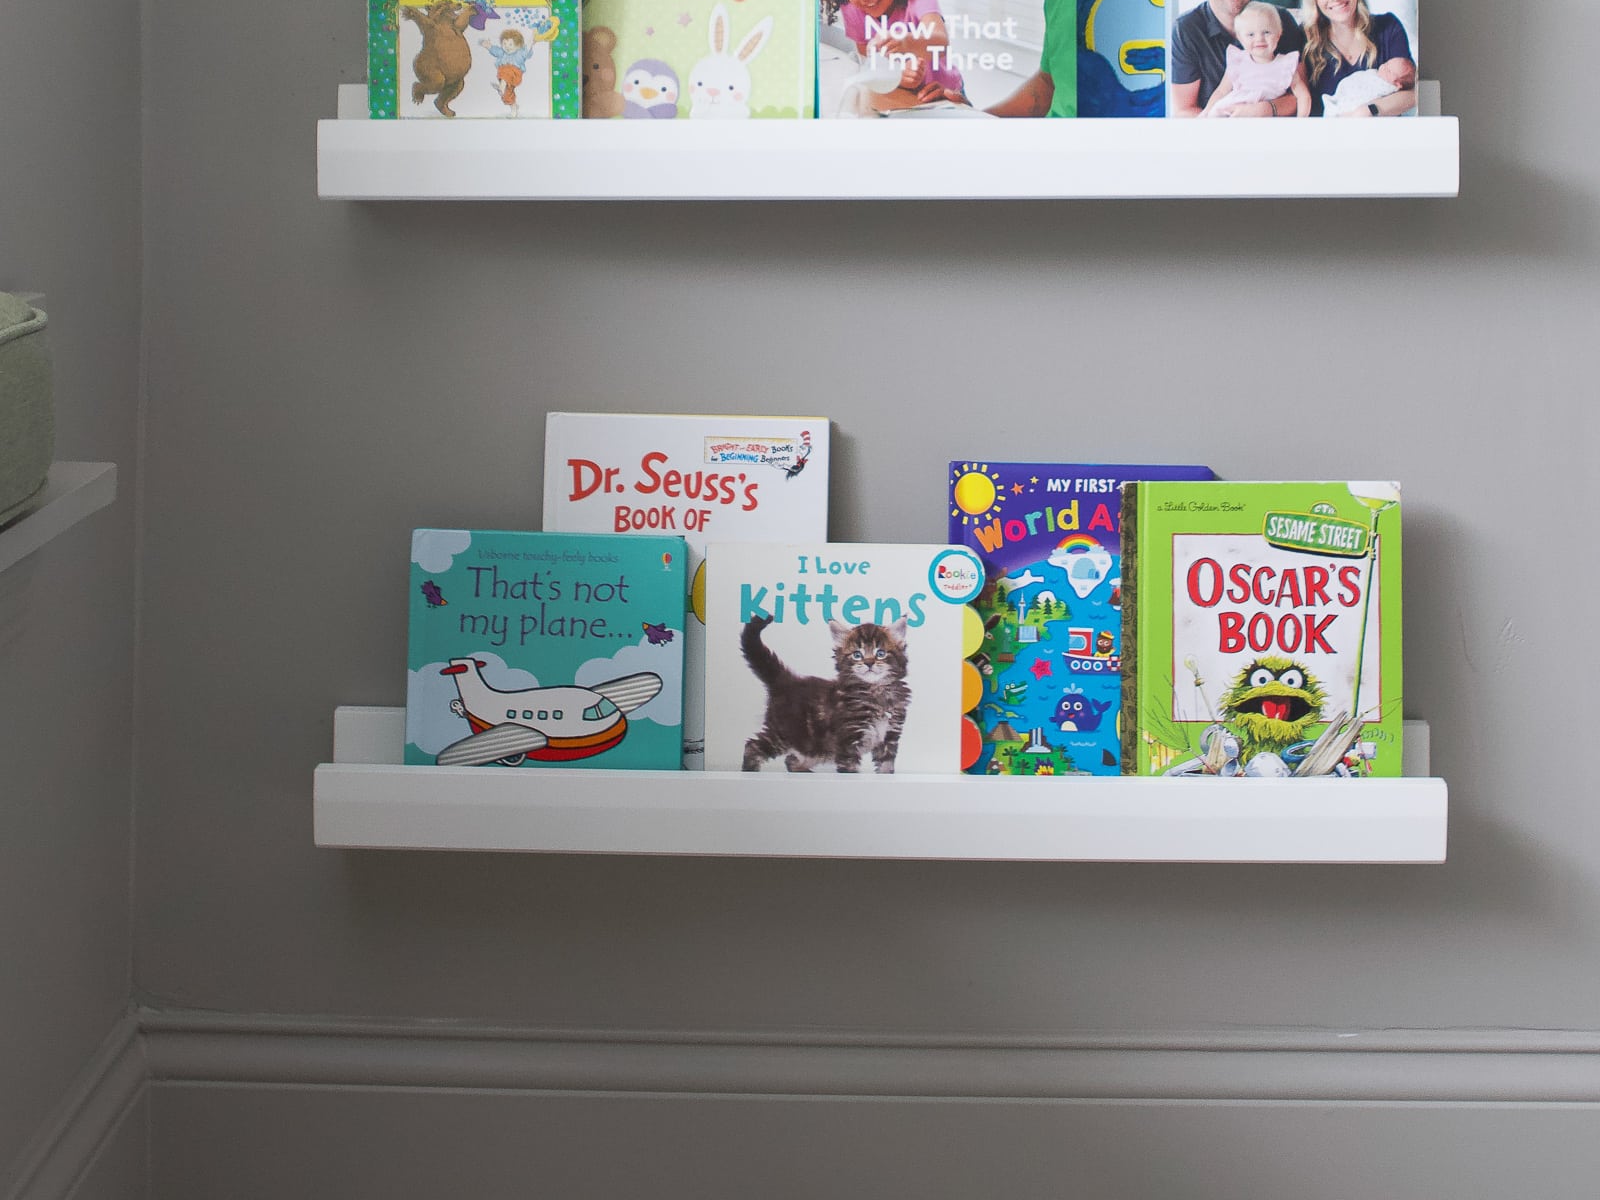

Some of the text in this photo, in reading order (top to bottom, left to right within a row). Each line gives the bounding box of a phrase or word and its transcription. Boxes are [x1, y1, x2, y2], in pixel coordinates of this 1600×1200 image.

[863, 13, 1018, 40] Now That
[869, 45, 1014, 72] I'm Three
[567, 451, 759, 512] Dr. Seuss's
[1046, 478, 1116, 494] MY FIRST
[613, 504, 712, 533] BOOK OF
[1164, 501, 1187, 512] Little
[1188, 500, 1220, 512] Golden
[1220, 501, 1245, 513] Book
[973, 499, 1080, 554] World
[1267, 516, 1363, 550] SESAME STREET
[478, 549, 520, 562] Usborne
[587, 551, 620, 564] books
[797, 555, 872, 576] I Love
[466, 564, 630, 604] That's not
[937, 565, 977, 580] Rookie
[1186, 556, 1362, 609] OSCAR'S
[739, 581, 928, 628] Kittens
[458, 601, 633, 647] my plane...
[1217, 611, 1339, 655] BOOK
